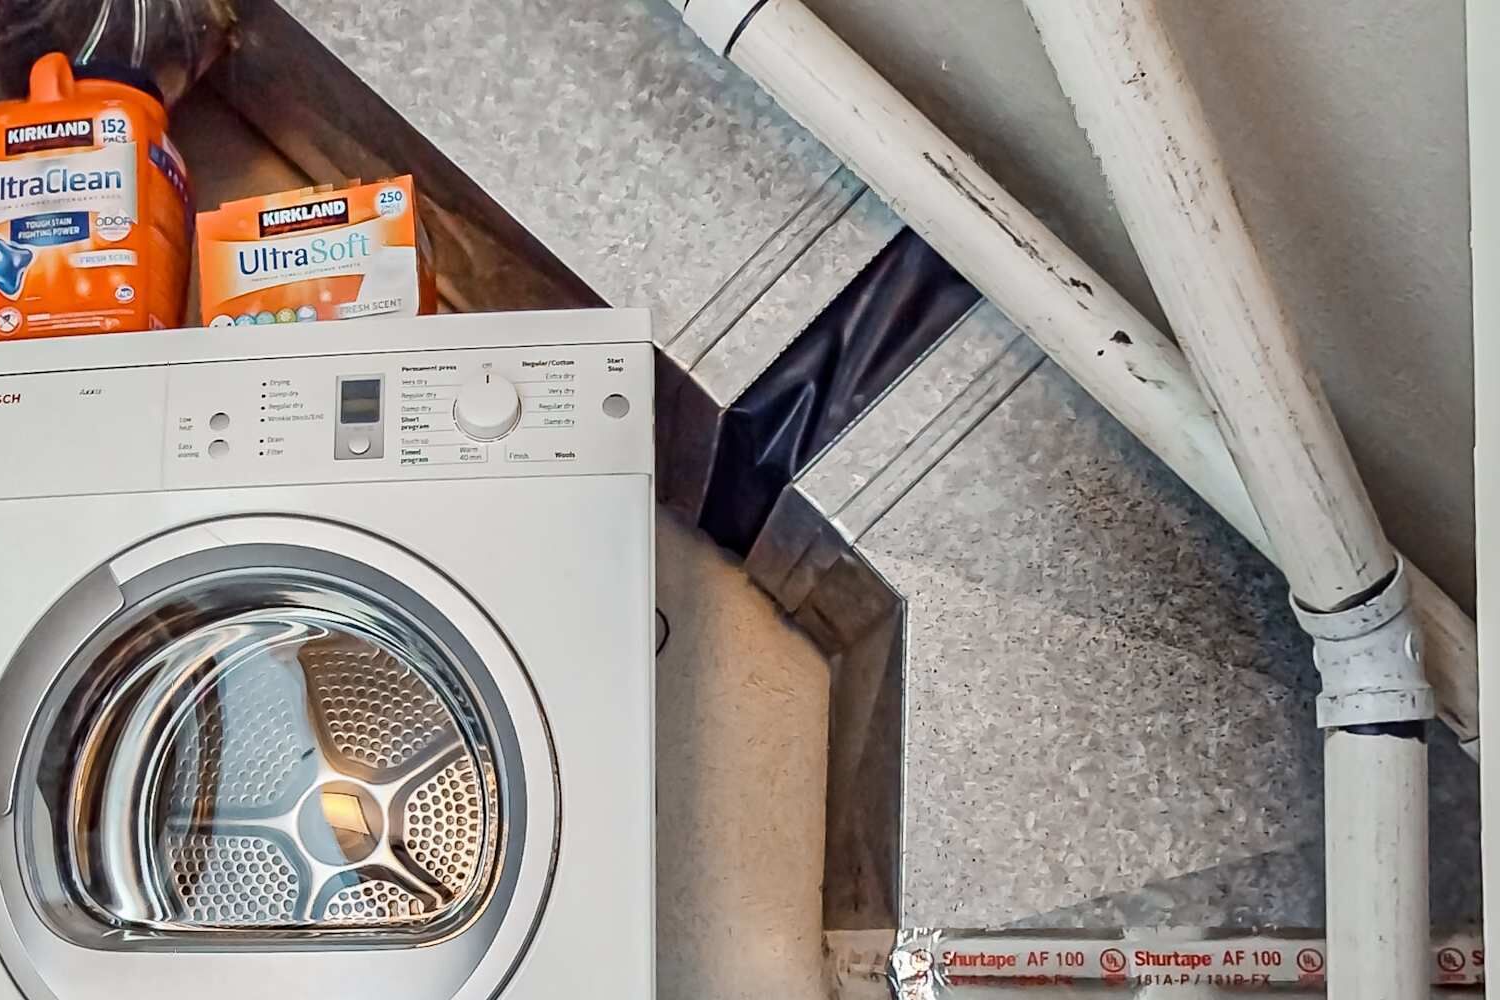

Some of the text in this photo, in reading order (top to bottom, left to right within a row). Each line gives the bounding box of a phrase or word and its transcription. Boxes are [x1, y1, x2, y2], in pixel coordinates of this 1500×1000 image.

[7, 121, 91, 144] KIRKLAND
[102, 119, 126, 134] 152
[103, 135, 127, 143] PACS
[380, 191, 403, 203] 250
[262, 200, 346, 227] KIRKLAND
[18, 226, 80, 239] FIGHTING POWER
[239, 233, 370, 276] UltraSoft
[340, 298, 403, 315] FRESH SCENT
[943, 951, 1017, 970] Shurtape
[1027, 952, 1049, 967] AF
[1057, 951, 1085, 967] 100
[1135, 951, 1282, 970] Shurtape AF 100
[1136, 974, 1190, 986] 181A-P
